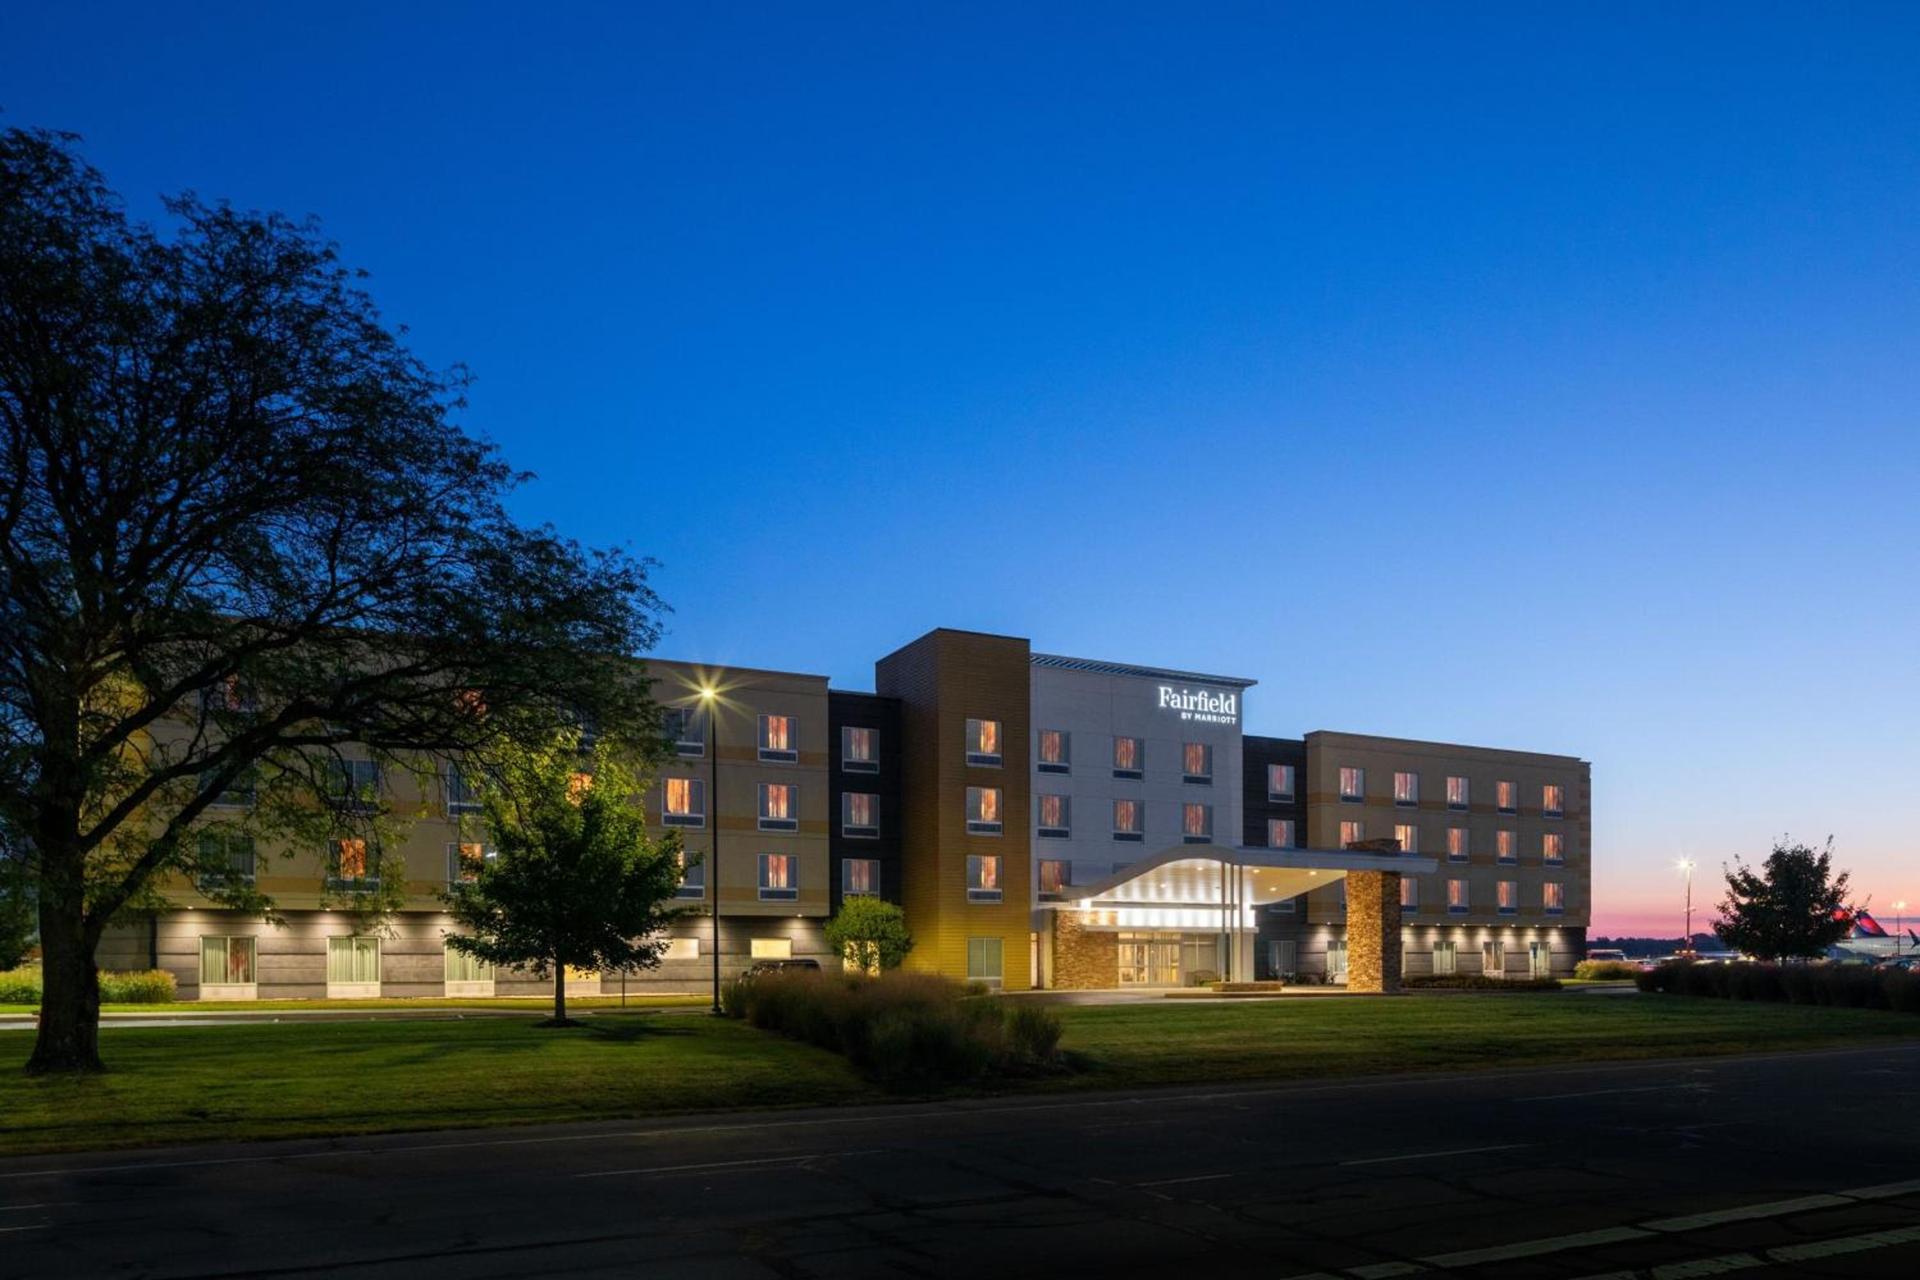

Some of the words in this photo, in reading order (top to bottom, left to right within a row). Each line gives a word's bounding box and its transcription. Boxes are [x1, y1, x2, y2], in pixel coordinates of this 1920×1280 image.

[1158, 686, 1236, 715] Fairfield
[1181, 711, 1193, 720] BY
[1195, 713, 1236, 725] MARRIOTT
